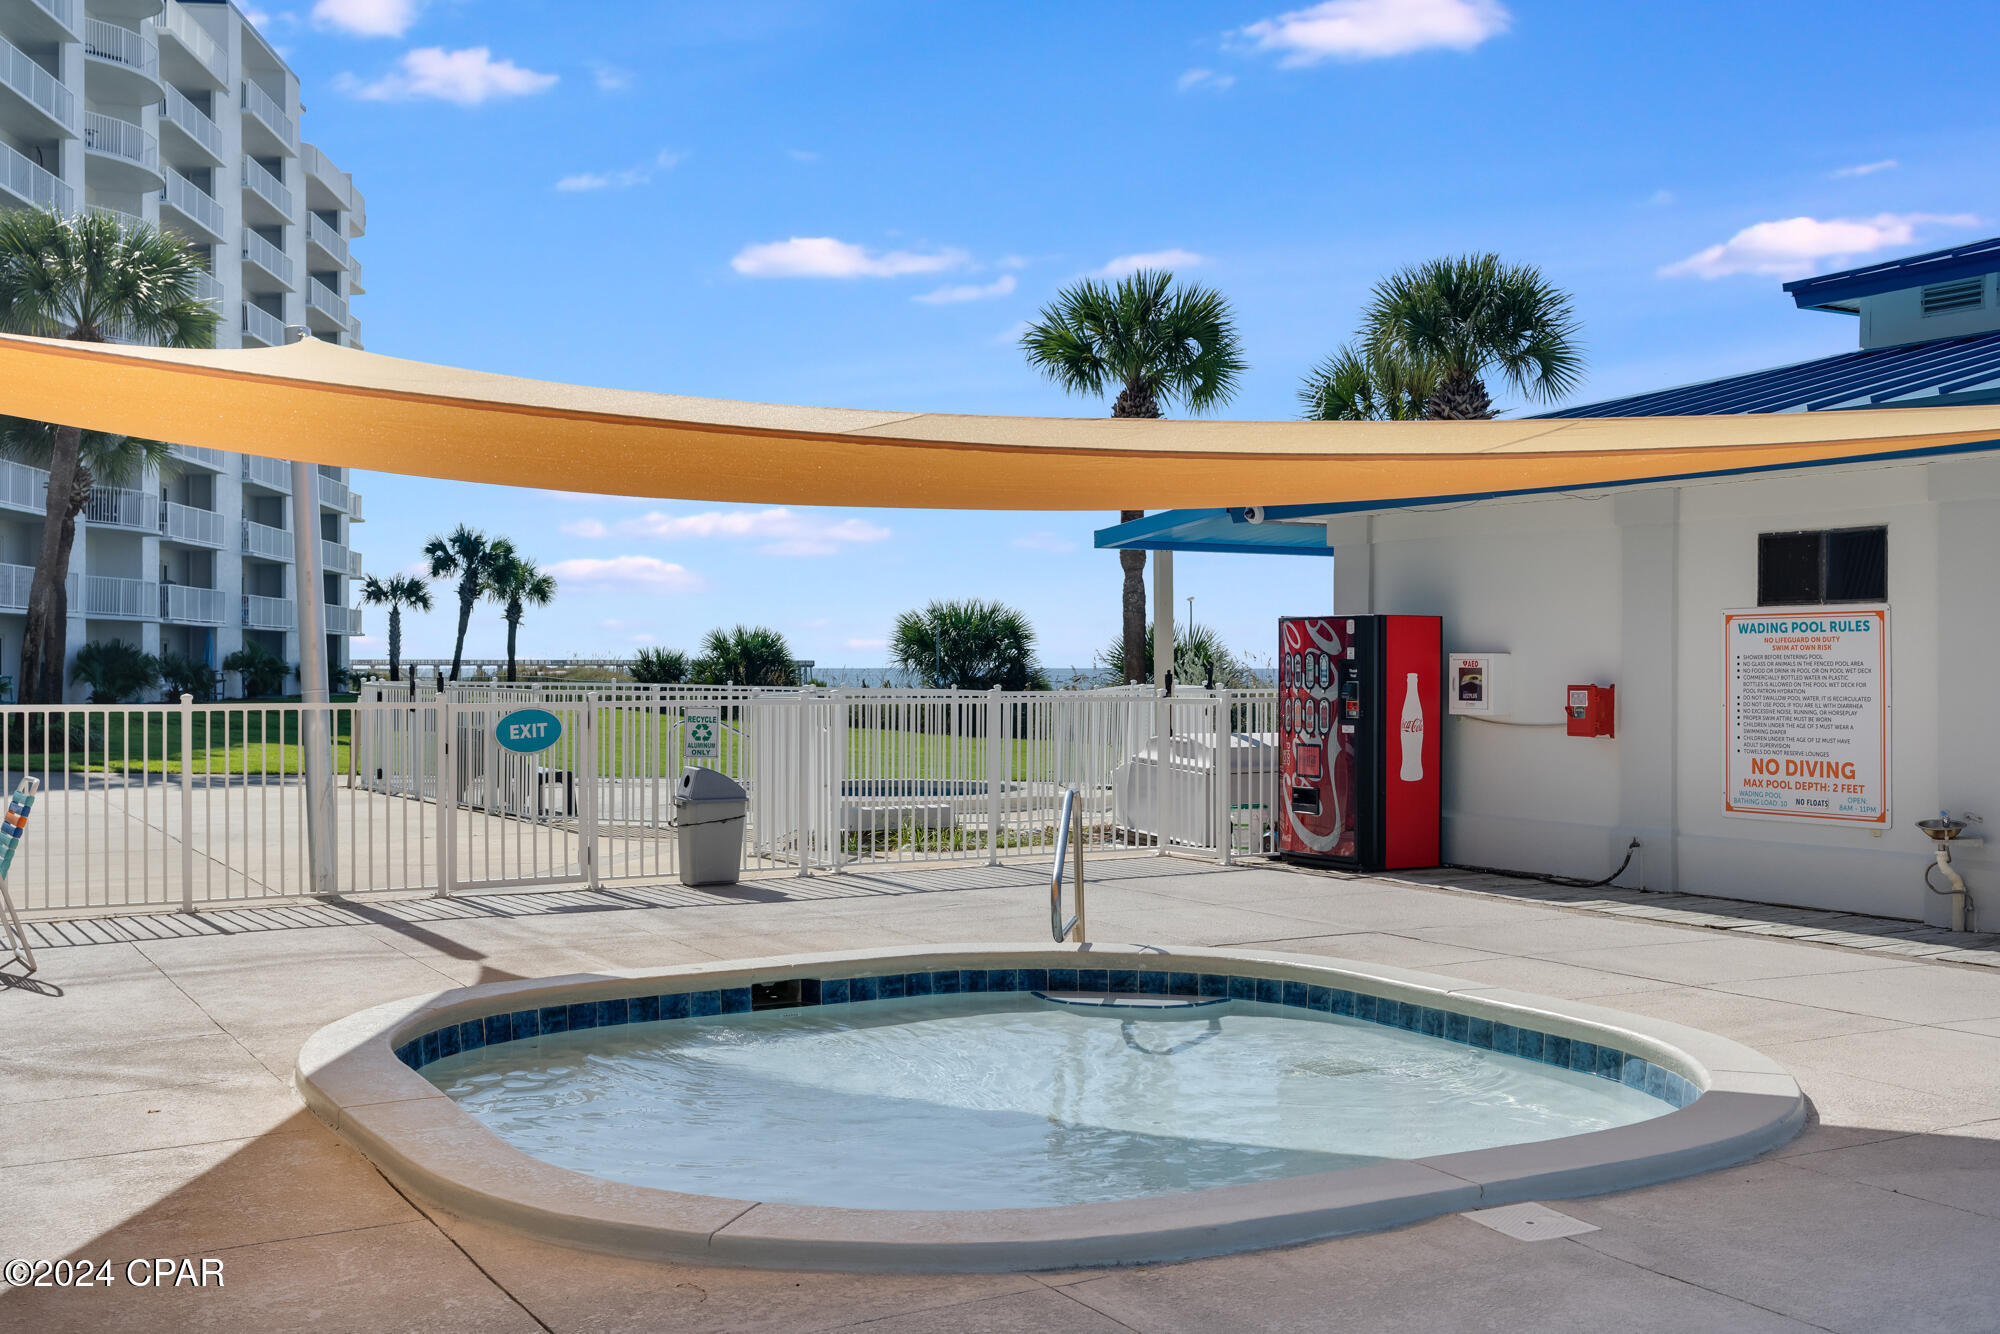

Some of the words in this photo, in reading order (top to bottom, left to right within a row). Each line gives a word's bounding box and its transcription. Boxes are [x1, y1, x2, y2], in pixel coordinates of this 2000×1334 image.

[1738, 622, 1787, 634] WADING
[1792, 621, 1826, 633] POOL
[1830, 620, 1870, 632] RULES
[1467, 660, 1479, 668] AED
[687, 715, 717, 724] RECYCLE
[509, 722, 549, 740] EXIT
[1752, 758, 1779, 775] NO
[1786, 760, 1855, 779] DIVING
[1744, 778, 1763, 787] MAX
[1767, 780, 1792, 789] POOL
[1795, 782, 1830, 792] DEPTH:
[1833, 784, 1838, 792] 2
[1841, 784, 1864, 793] FEET
